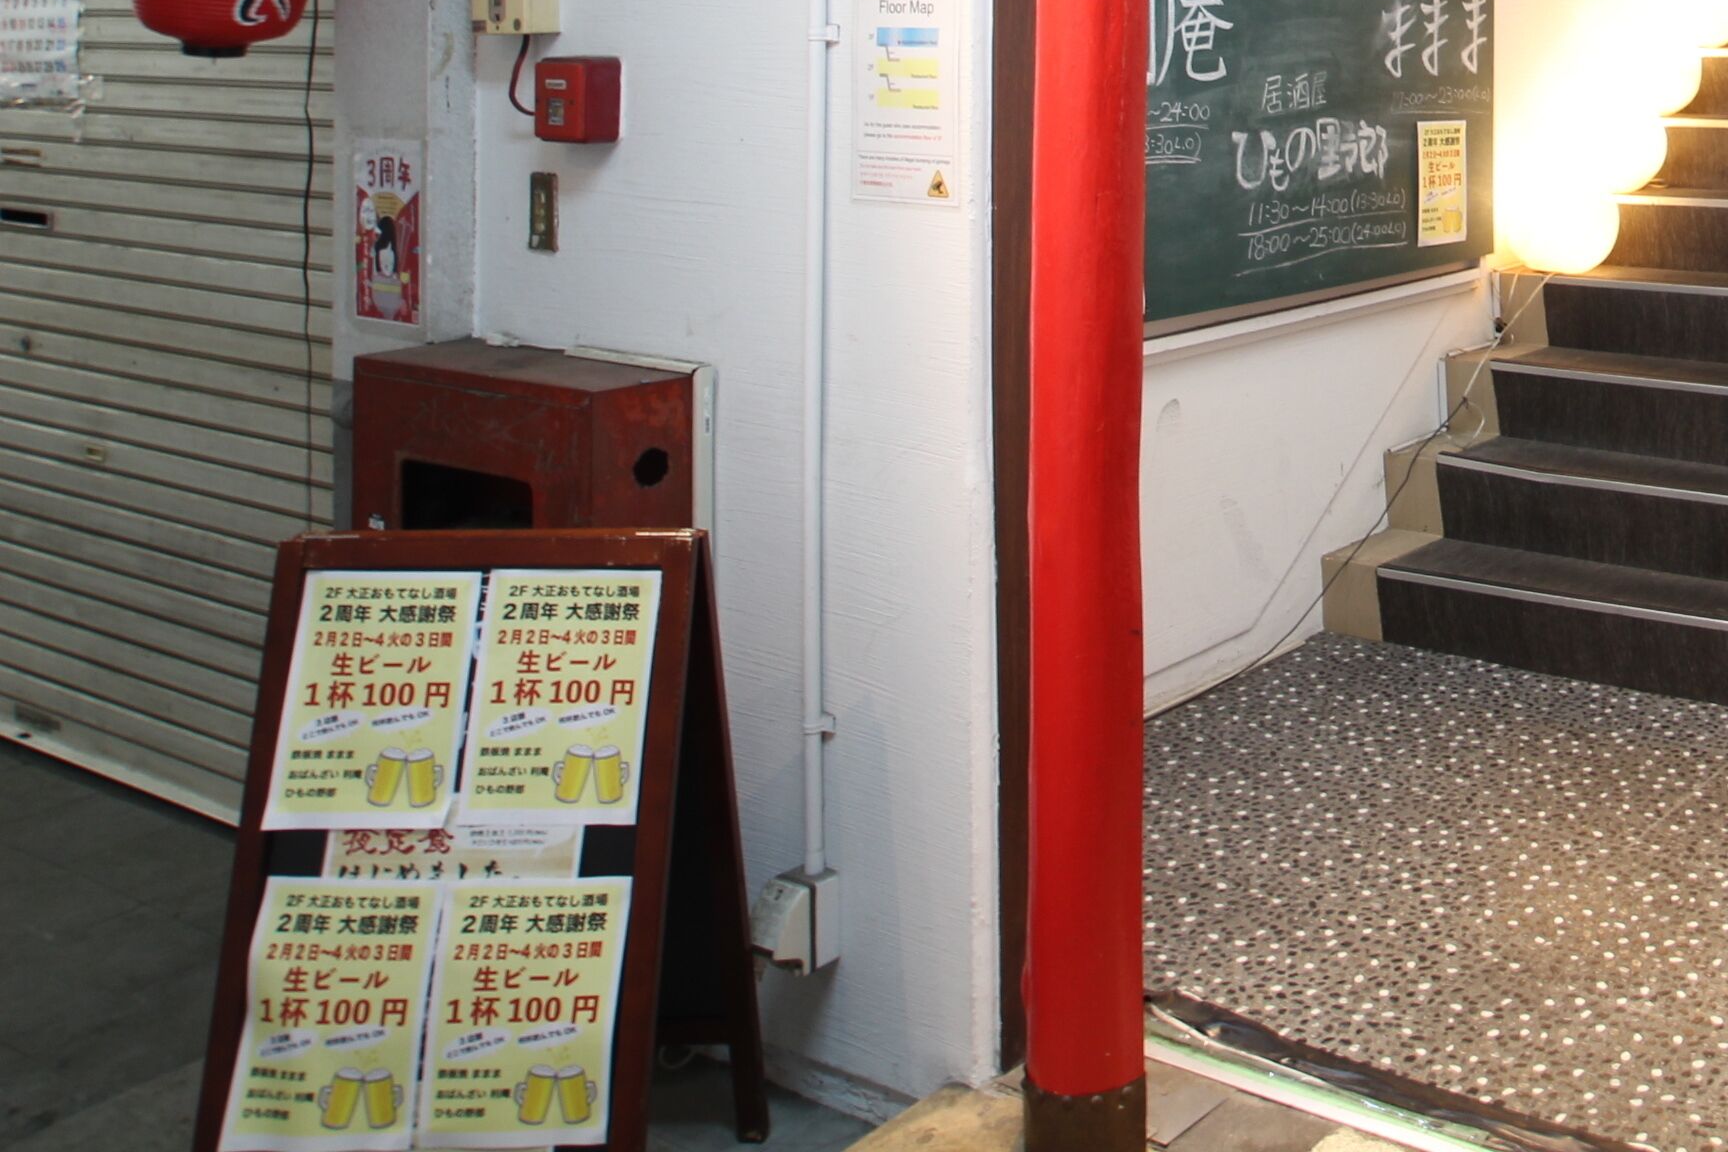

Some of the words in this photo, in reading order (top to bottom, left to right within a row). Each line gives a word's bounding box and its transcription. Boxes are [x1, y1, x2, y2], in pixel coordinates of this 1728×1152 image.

[879, 0, 907, 15] Floor
[910, 1, 934, 17] Map
[1262, 72, 1327, 113] 居酒屋
[1233, 117, 1388, 191] ひもの野郎
[367, 157, 411, 190] 3周年
[325, 588, 341, 599] 2F
[346, 589, 456, 600] 大正おもてなし酒場
[509, 586, 525, 596] 2F
[531, 587, 639, 598] 大正おもてなし酒場
[319, 605, 373, 624] 2周年
[379, 606, 457, 624] 大感謝祭
[503, 603, 558, 622] 2周年
[565, 604, 641, 621] 大感謝祭
[331, 653, 433, 676] 生ビール
[517, 650, 618, 673] 生ビール
[286, 897, 303, 907] 2F
[307, 897, 420, 909] 大正おもてなし酒場
[469, 897, 486, 907] 2F
[491, 895, 608, 907] 大正おもてなし酒場
[276, 915, 332, 934] 2周年
[338, 915, 421, 934] 大感謝祭
[461, 914, 519, 933] 2周年
[525, 913, 609, 932] 大感謝祭
[284, 965, 392, 990] 生ビール
[473, 965, 581, 990] 生ビール
